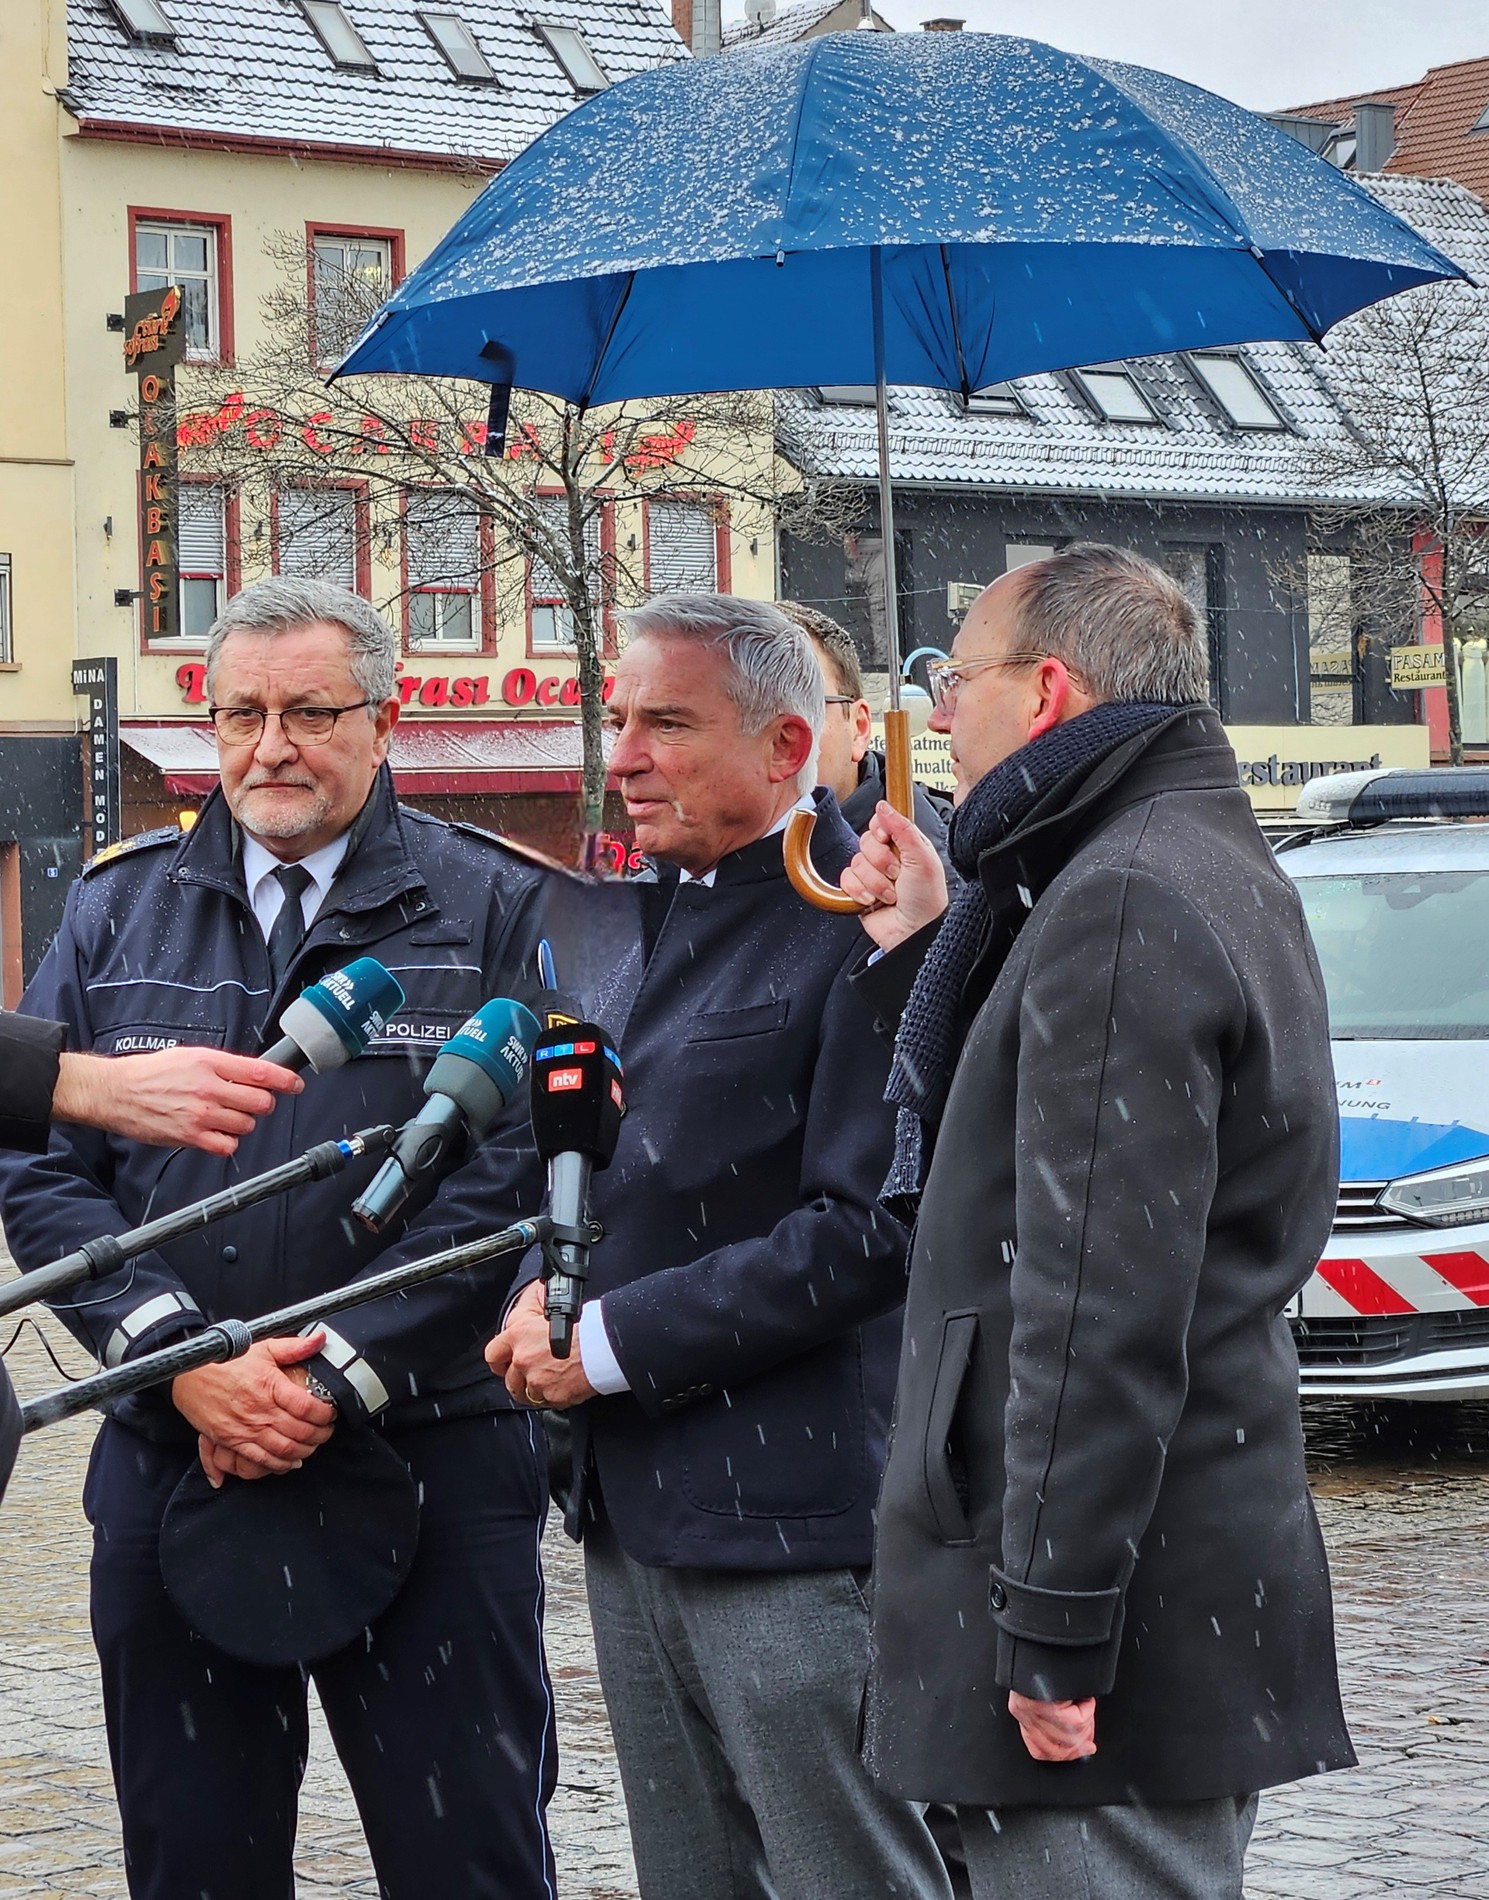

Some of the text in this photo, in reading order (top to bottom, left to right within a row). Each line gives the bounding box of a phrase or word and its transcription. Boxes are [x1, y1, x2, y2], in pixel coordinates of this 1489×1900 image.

[1393, 670, 1448, 683] Restaurant
[93, 698, 105, 781] DAMEN
[385, 1023, 451, 1039] POLIZEI
[539, 1044, 590, 1058] RTL
[552, 1072, 578, 1087] ntv
